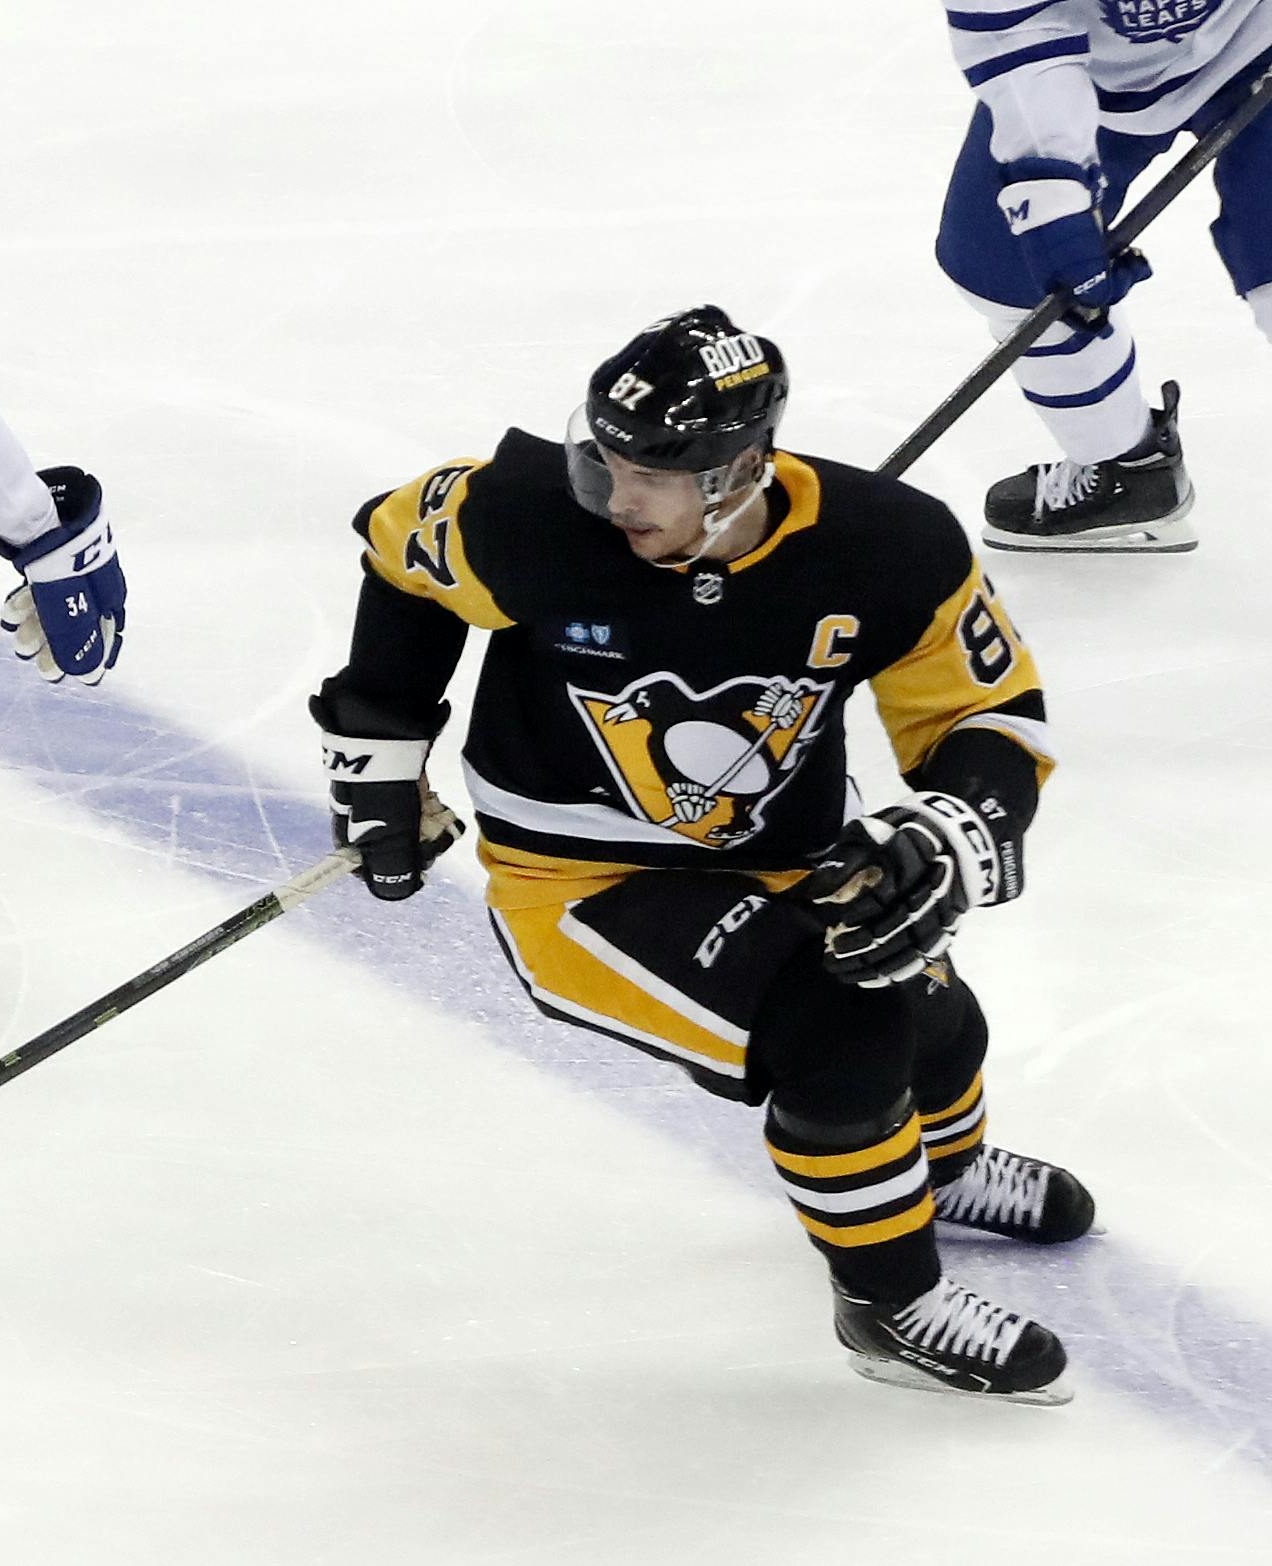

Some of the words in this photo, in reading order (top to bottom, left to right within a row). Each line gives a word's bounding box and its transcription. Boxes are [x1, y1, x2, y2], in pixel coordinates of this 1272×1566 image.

[1118, 0, 1188, 14] MAP
[1122, 0, 1208, 27] LEAFS
[608, 372, 656, 412] 87
[595, 415, 634, 443] CCM
[404, 463, 477, 590] 87
[65, 592, 89, 617] 34
[806, 613, 861, 669] C
[979, 797, 1008, 822] 87
[921, 794, 996, 897] CCM
[372, 872, 413, 885] CCM
[898, 1348, 959, 1376] CCM
